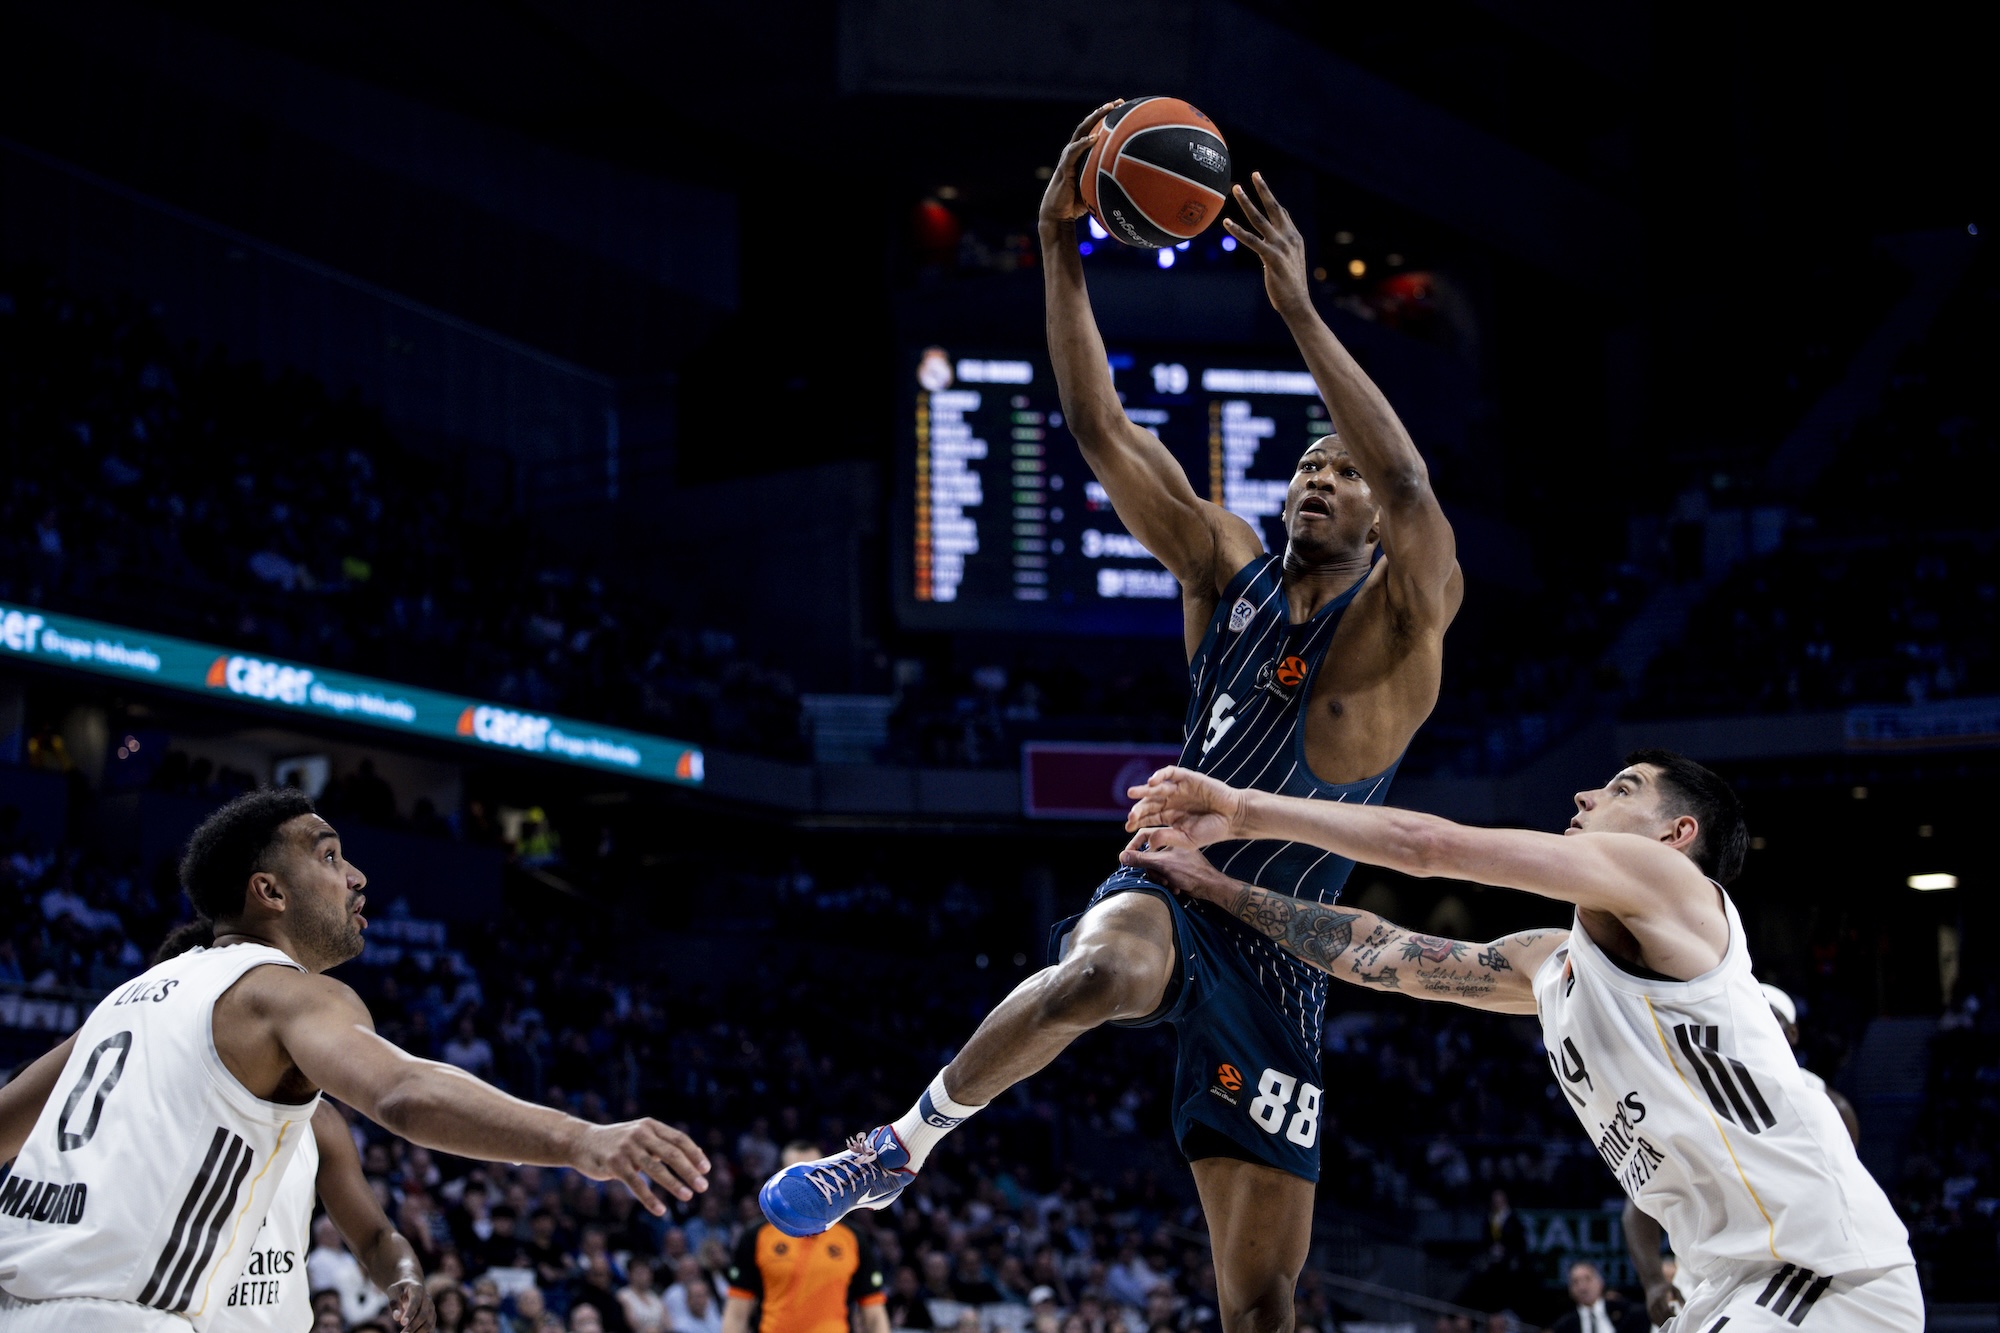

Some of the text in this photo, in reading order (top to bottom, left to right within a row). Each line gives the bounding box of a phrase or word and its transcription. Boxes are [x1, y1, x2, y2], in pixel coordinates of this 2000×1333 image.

[1235, 602, 1252, 619] 50
[226, 655, 314, 705] caser
[475, 705, 551, 752] caser
[113, 978, 180, 1007] LYLES
[57, 1030, 133, 1153] 0
[1249, 1067, 1324, 1149] 88
[0, 1174, 88, 1226] MADRID
[228, 1280, 280, 1307] BETTER
